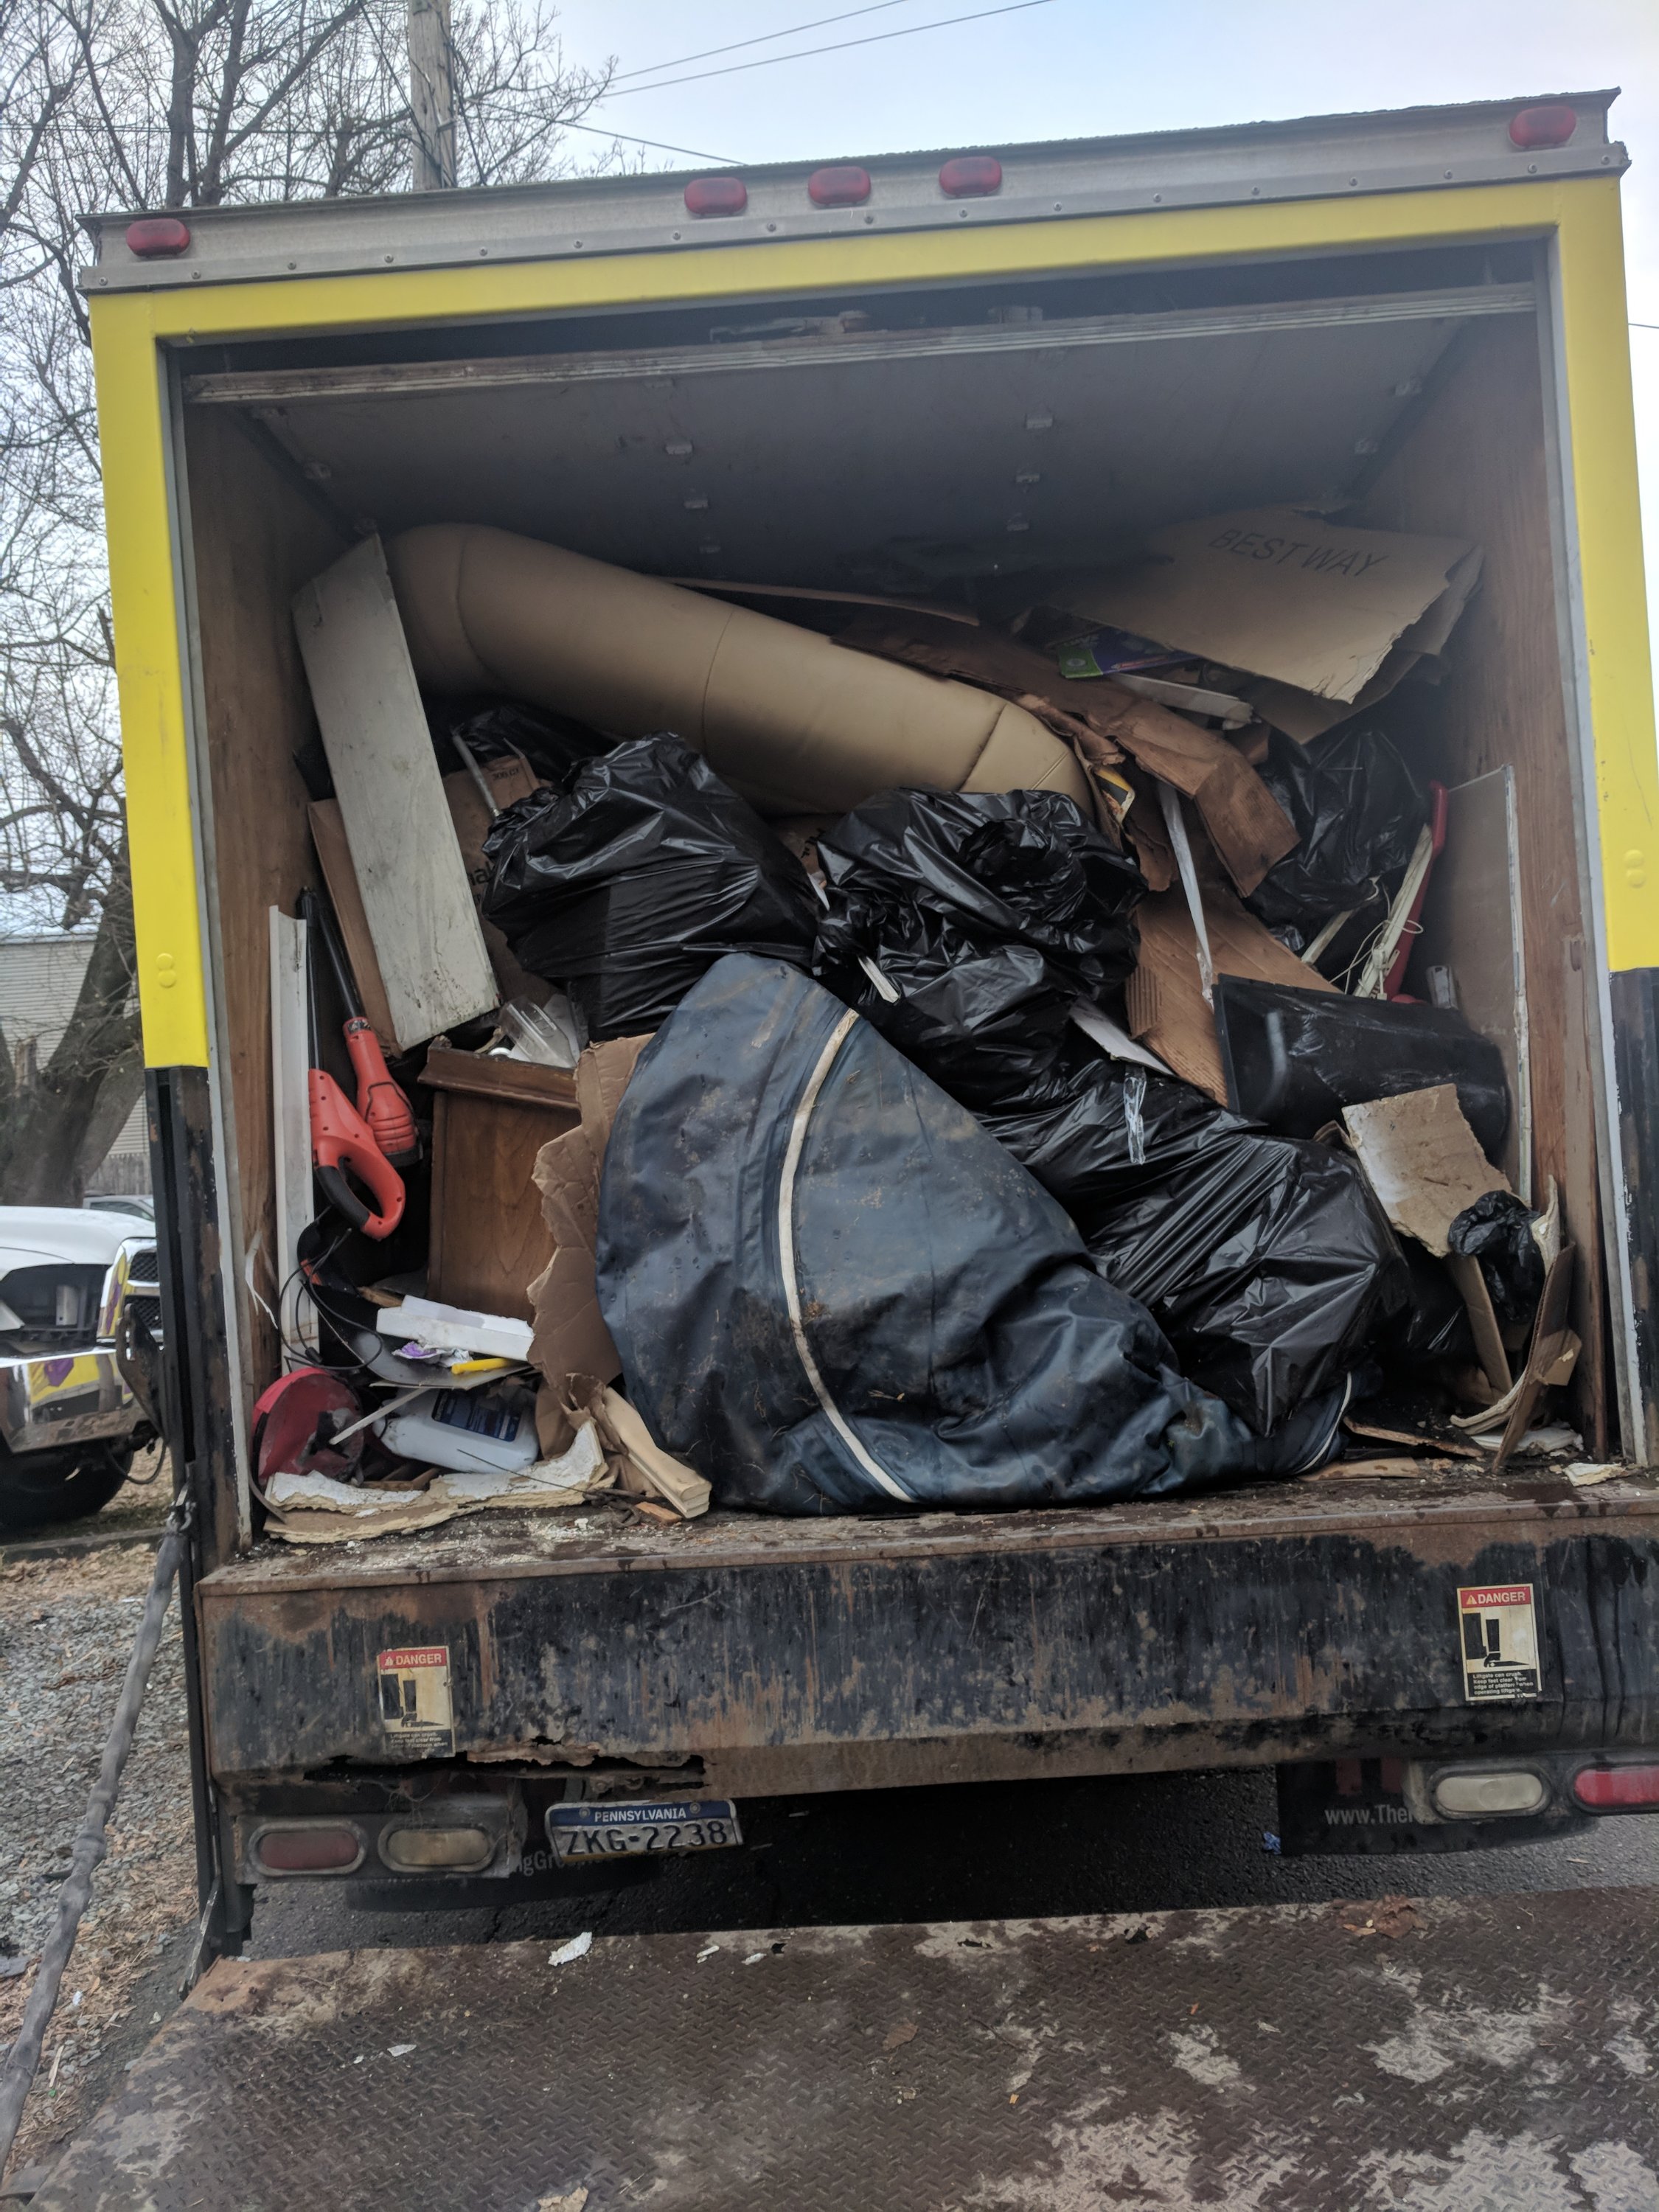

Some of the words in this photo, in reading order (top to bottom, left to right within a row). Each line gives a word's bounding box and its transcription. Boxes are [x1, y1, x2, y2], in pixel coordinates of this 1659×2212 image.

[1477, 1591, 1526, 1604] DANGER
[395, 1652, 442, 1666] DANGER
[594, 1806, 687, 1823] PENNSYLVANIA
[560, 1820, 729, 1856] ZKG-2238
